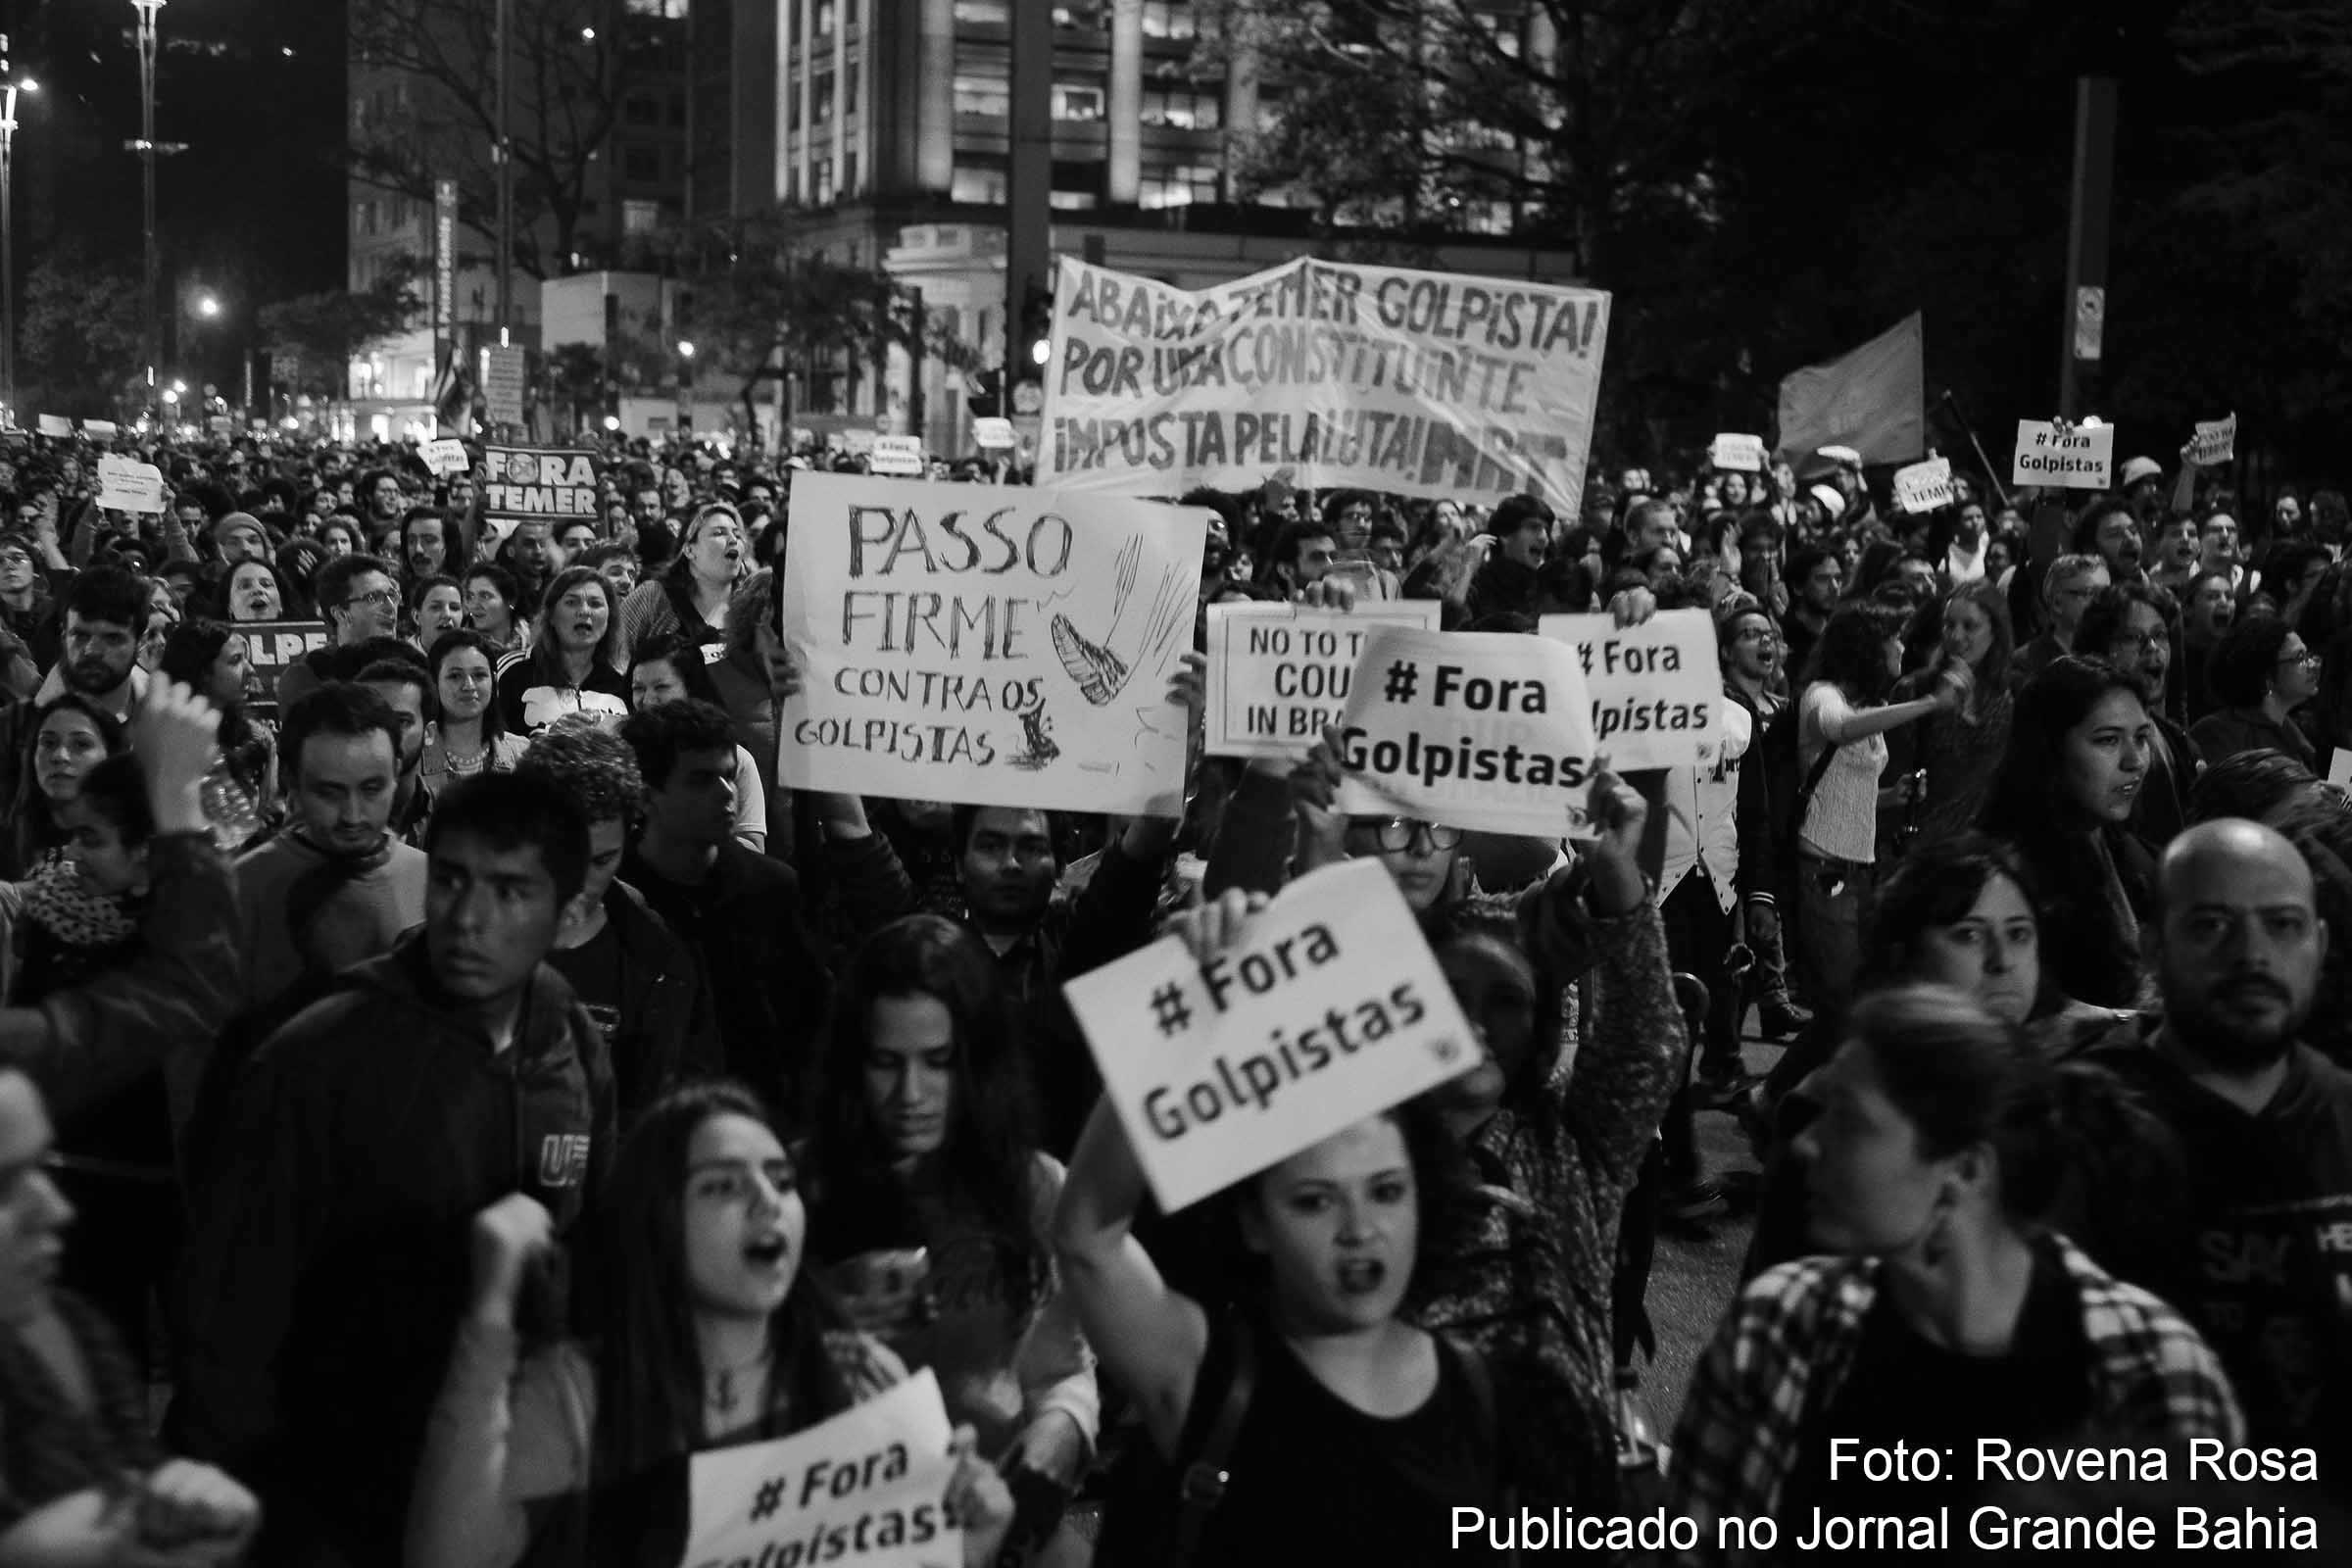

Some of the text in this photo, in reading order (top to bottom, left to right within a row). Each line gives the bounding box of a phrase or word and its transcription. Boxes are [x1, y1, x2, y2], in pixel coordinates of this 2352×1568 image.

[1228, 267, 1361, 325] TEMER
[1060, 336, 1144, 398] POR
[1152, 339, 1226, 396] UMA
[1235, 410, 1319, 466] PELA
[485, 451, 597, 487] FORA
[2019, 453, 2104, 474] Golpistas
[485, 484, 597, 514] TEMER
[849, 504, 1073, 579] PASSO
[242, 632, 328, 665] LPE
[843, 590, 1029, 661] FIRME
[1250, 627, 1368, 658] NO TO T
[1275, 662, 1350, 699] COU
[1604, 640, 1681, 674] Fora
[834, 666, 993, 713] CONTRA
[1385, 659, 1547, 714] # Fora
[794, 717, 996, 767] GOLPISTAS
[1248, 706, 1277, 736] IN
[1592, 697, 1709, 742] lpistas
[1342, 726, 1586, 788] Golpistas
[1149, 922, 1341, 1038] # Fora
[1144, 982, 1426, 1141] Golpistas
[750, 1442, 908, 1522] # Fora
